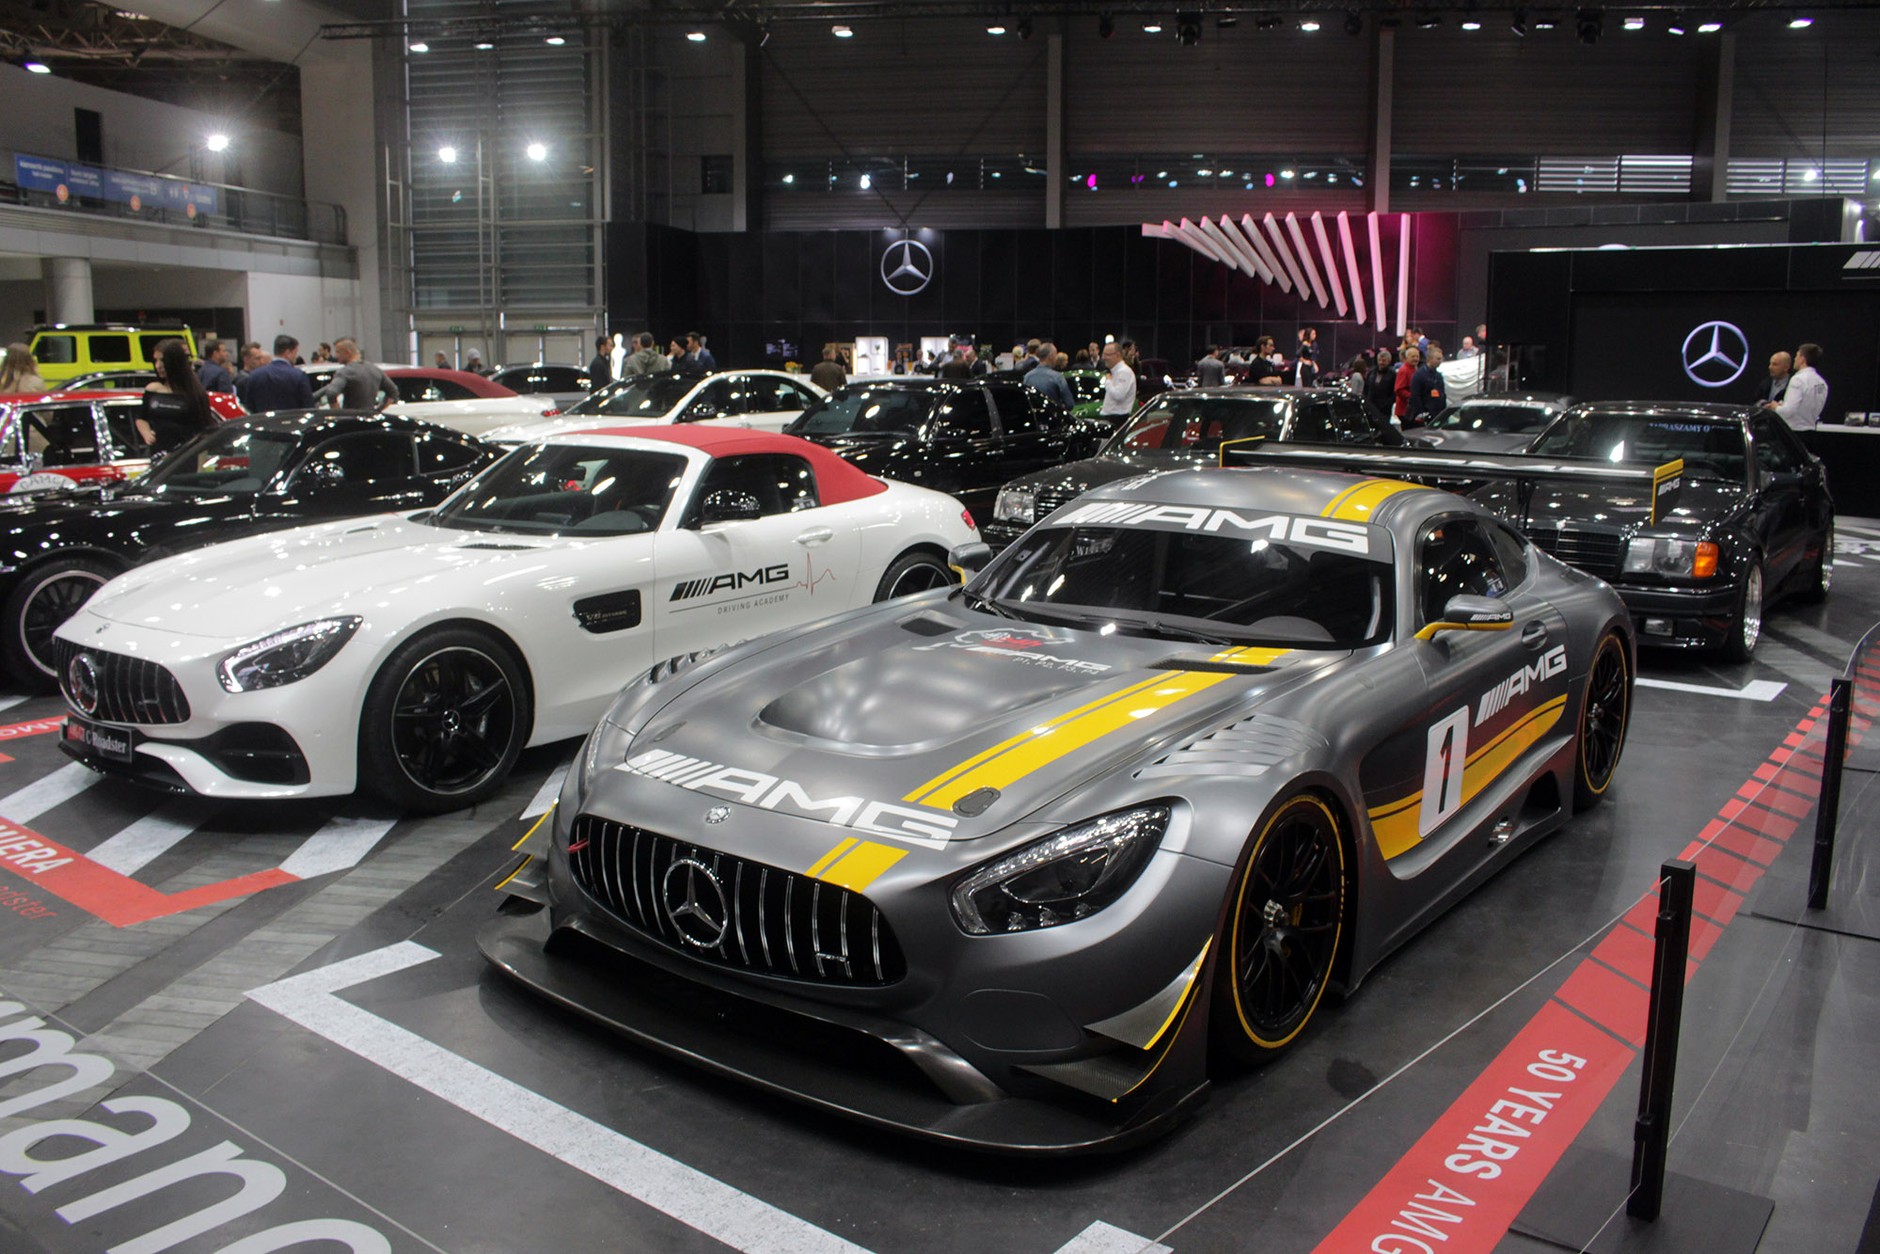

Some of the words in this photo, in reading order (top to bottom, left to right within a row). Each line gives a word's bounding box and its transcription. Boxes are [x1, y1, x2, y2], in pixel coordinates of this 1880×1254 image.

[1121, 505, 1370, 555] AMG
[717, 601, 751, 615] DRIVING
[753, 594, 790, 607] ACADEMY
[92, 731, 127, 754] Roadster
[1439, 725, 1454, 814] 1
[682, 767, 959, 851] AMG
[1526, 1049, 1587, 1082] 50
[1444, 1087, 1563, 1180] YEARS
